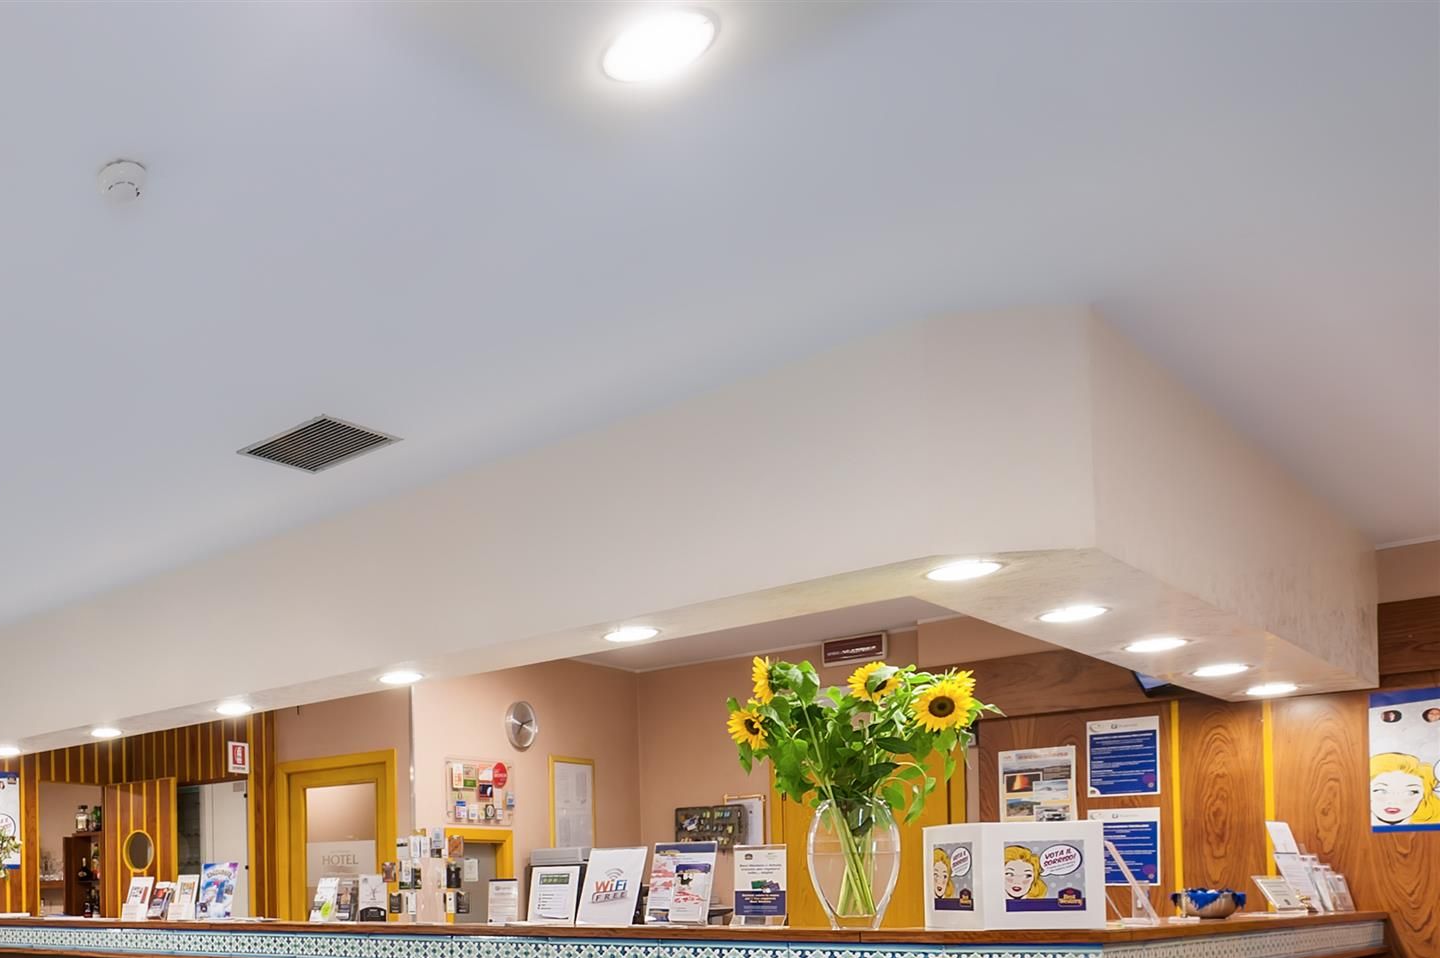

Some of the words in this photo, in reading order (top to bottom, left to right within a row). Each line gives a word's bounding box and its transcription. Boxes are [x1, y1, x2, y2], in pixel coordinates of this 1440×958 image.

[321, 854, 359, 865] HOTEL
[1044, 848, 1064, 860] VOTA
[595, 879, 628, 892] WiFi
[595, 892, 626, 902] FREE
